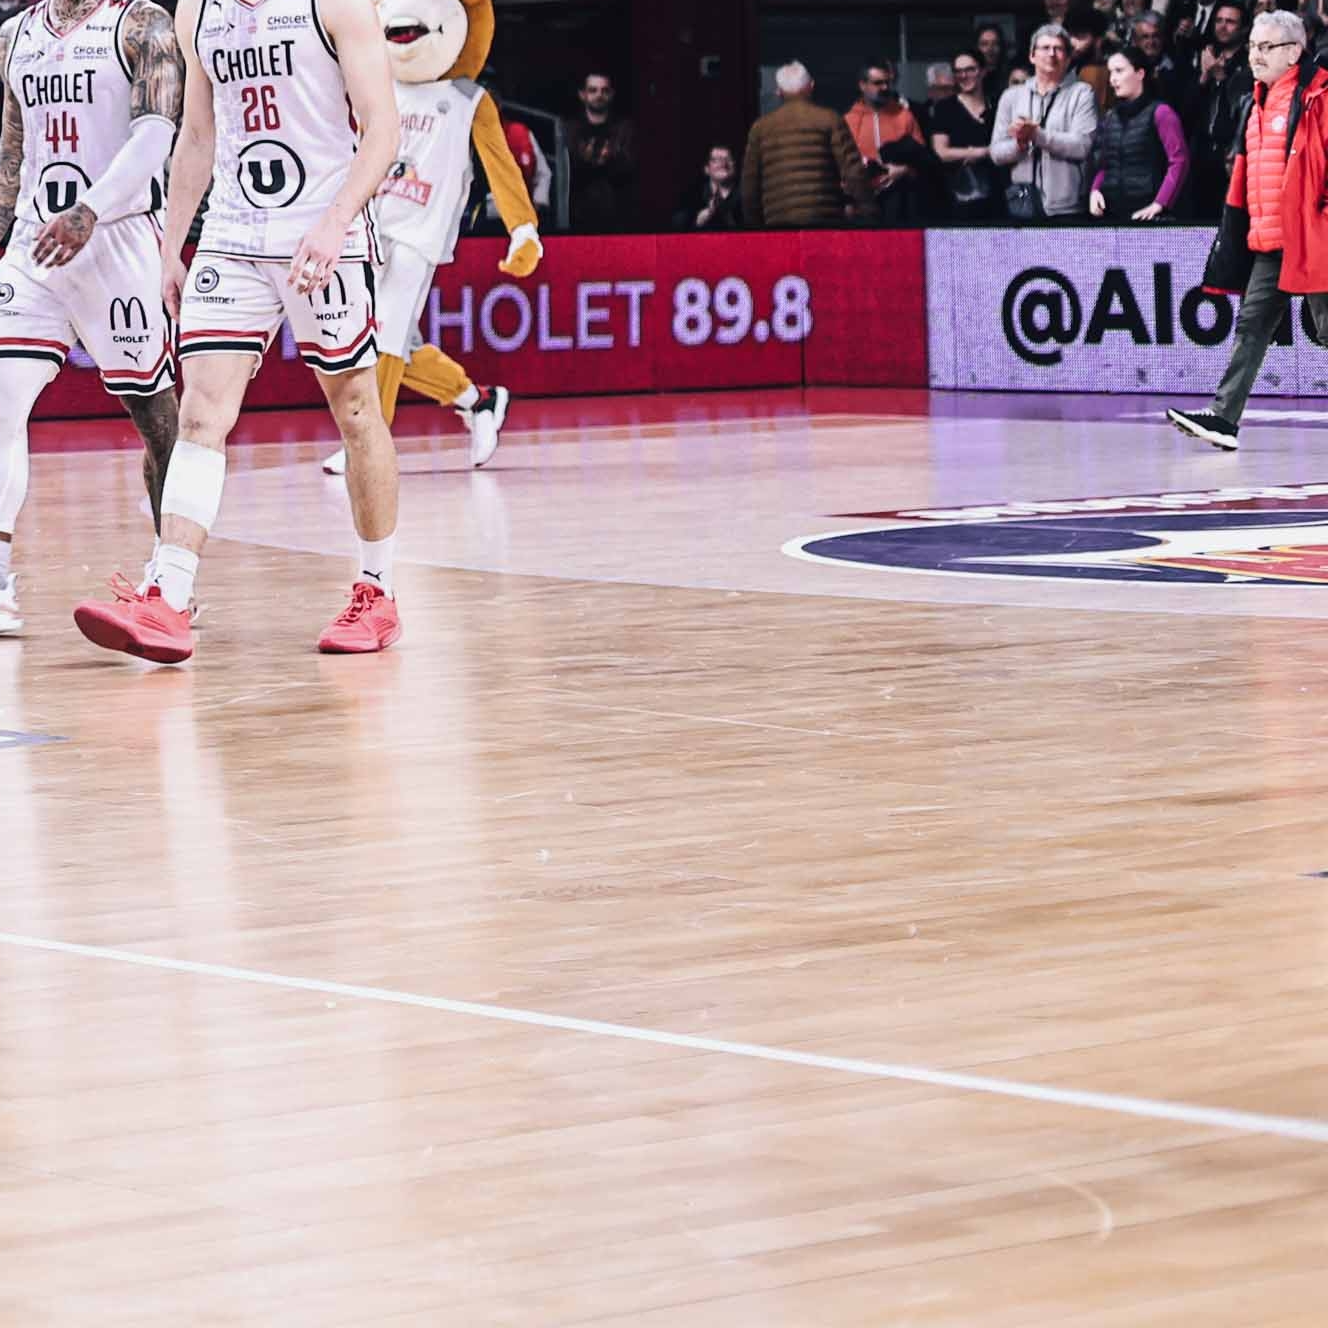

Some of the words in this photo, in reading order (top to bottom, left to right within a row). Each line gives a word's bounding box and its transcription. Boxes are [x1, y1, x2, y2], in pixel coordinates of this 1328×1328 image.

[212, 40, 295, 84] CHOLET
[22, 70, 96, 108] CHOLET
[241, 85, 281, 132] 26
[45, 111, 79, 153] 44
[248, 159, 286, 195] U
[429, 281, 656, 353] HOLET
[672, 275, 813, 346] 89.8
[113, 334, 150, 343] CHOLET
